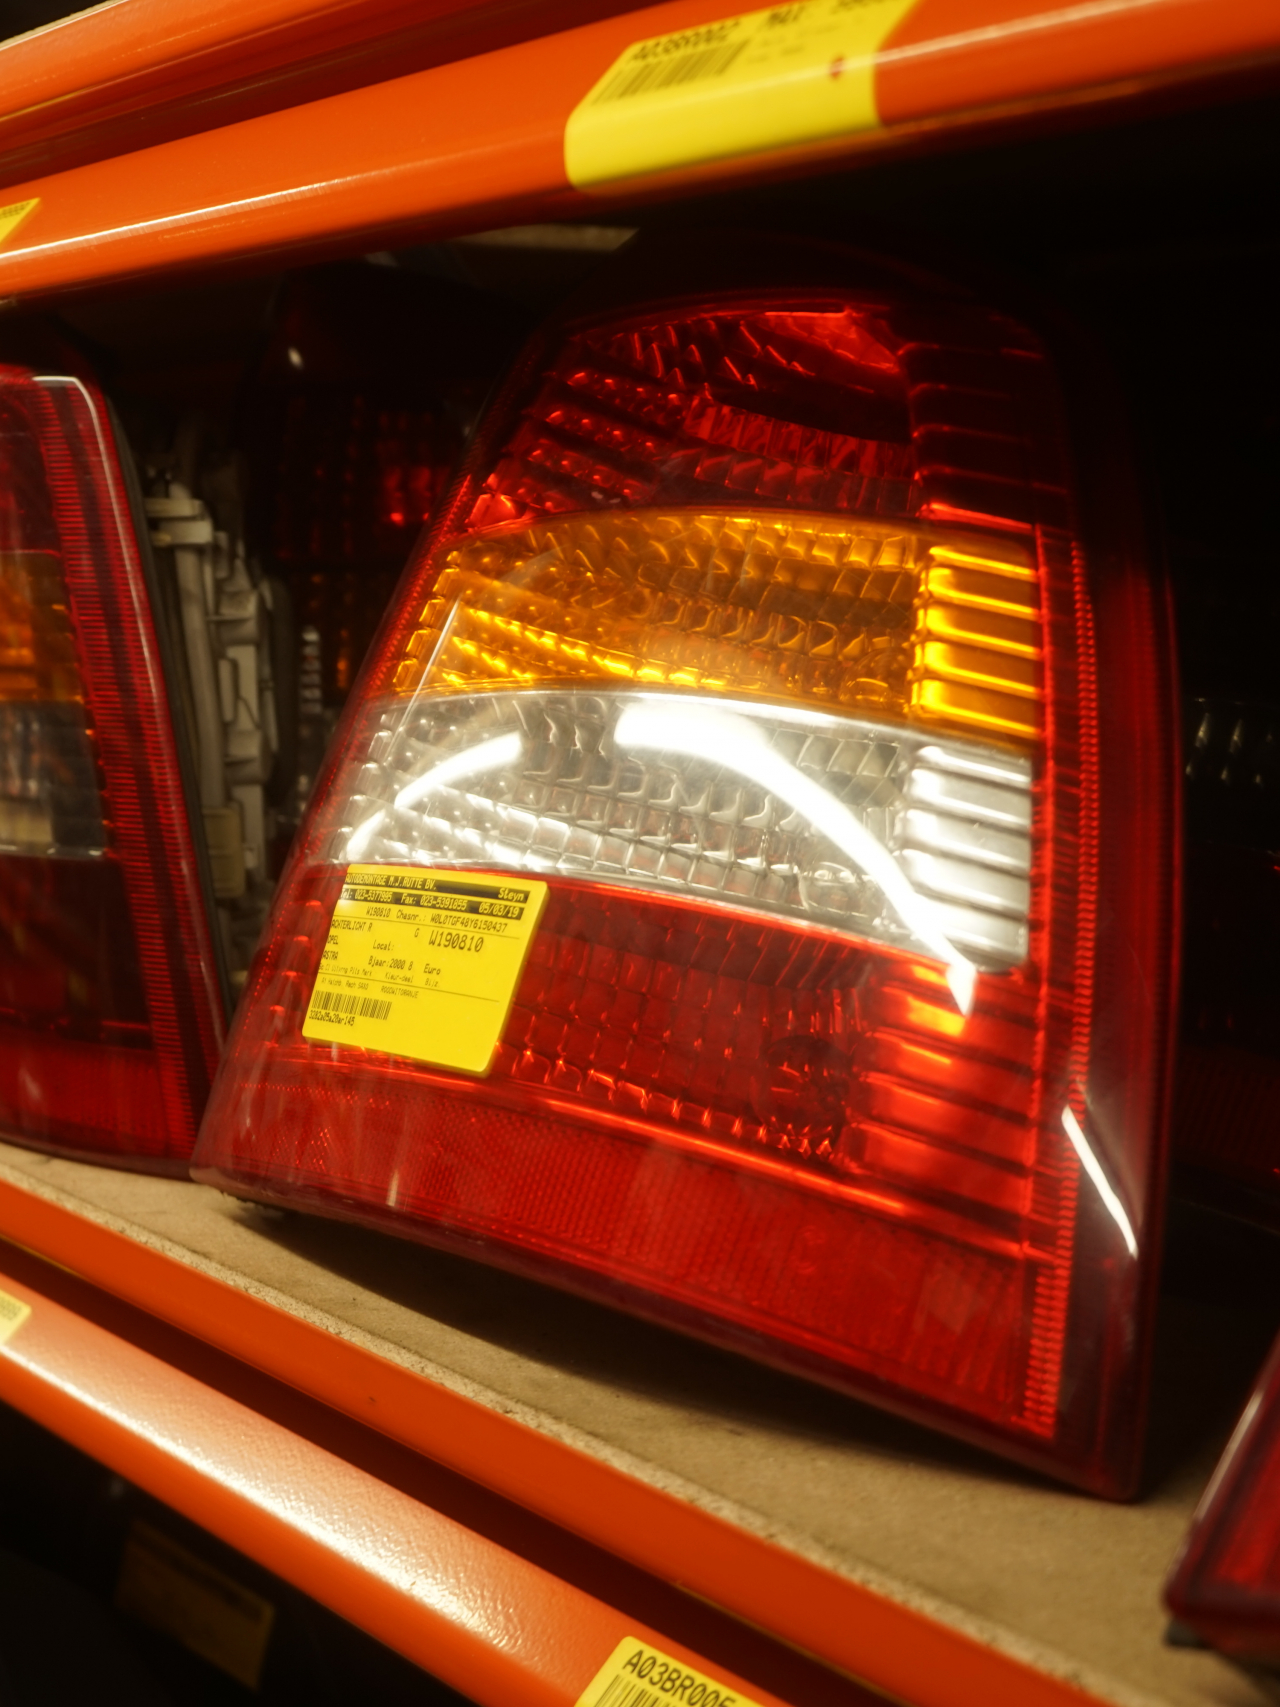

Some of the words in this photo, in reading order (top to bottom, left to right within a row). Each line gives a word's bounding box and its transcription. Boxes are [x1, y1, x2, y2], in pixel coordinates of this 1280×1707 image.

[345, 872, 387, 885] AUTODEMONTAGE
[497, 887, 524, 902] Steyn
[400, 893, 417, 905] Fax:
[478, 902, 520, 918] 05/03/19
[428, 929, 484, 953] W190810
[423, 963, 441, 976] Euro
